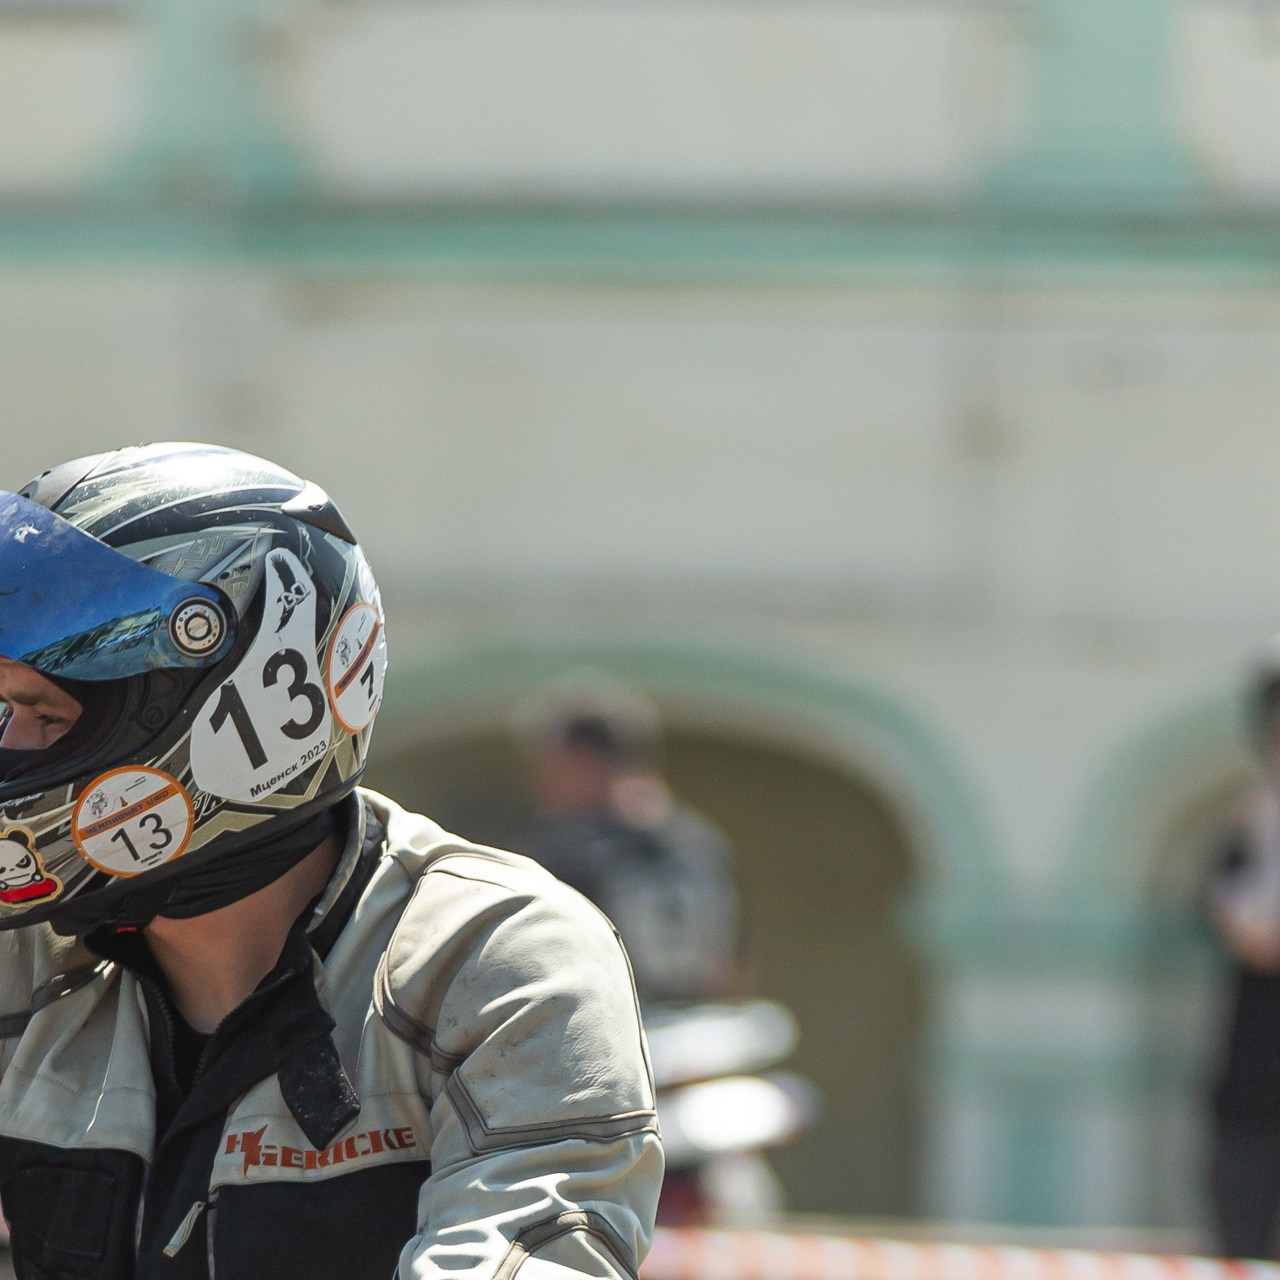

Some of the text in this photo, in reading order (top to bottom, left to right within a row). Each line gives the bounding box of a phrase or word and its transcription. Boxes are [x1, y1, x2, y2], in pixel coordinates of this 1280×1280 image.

[209, 648, 325, 770] 13
[250, 740, 327, 797] Мценск 2023
[111, 812, 172, 861] 13
